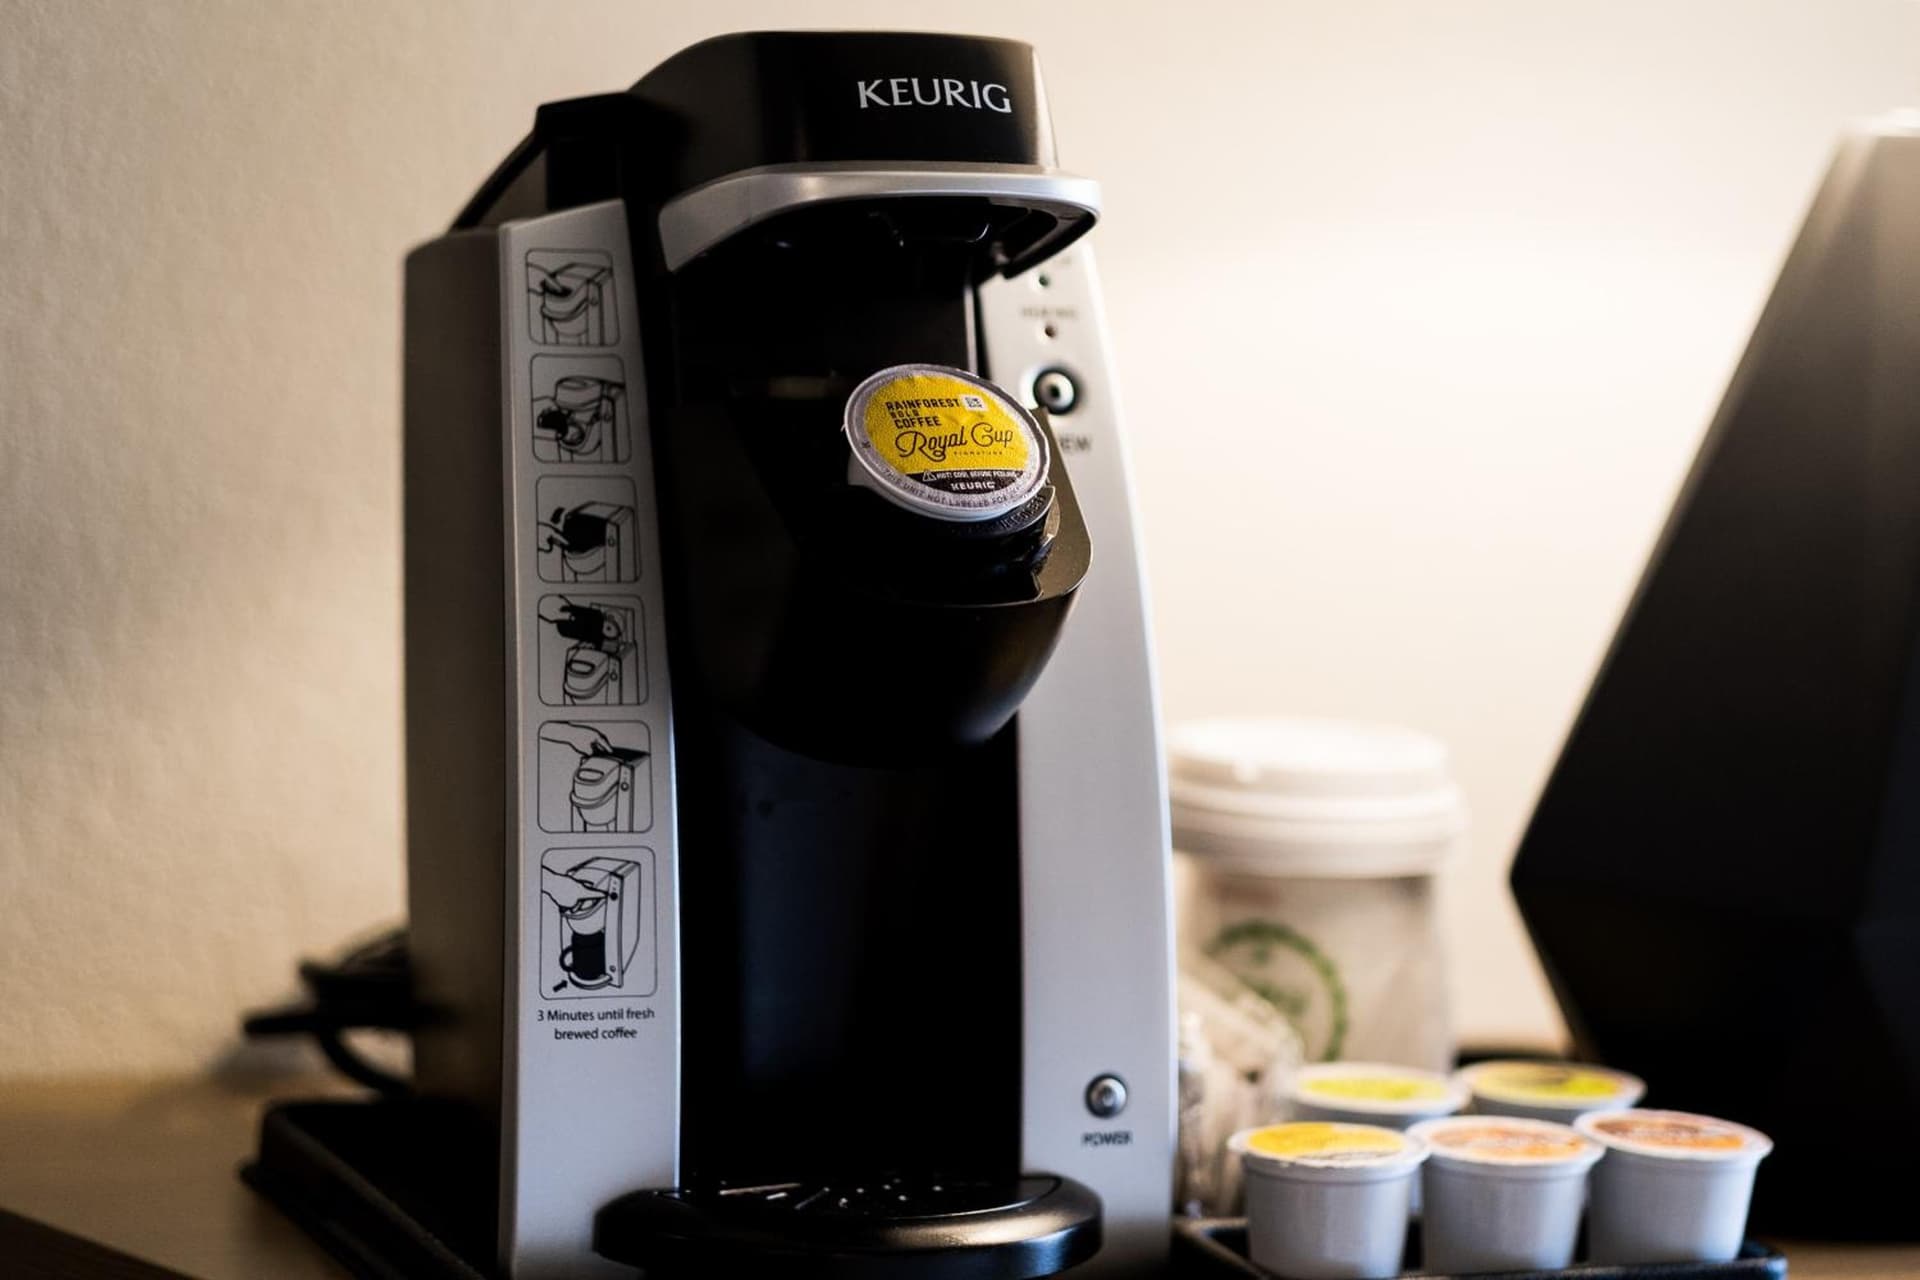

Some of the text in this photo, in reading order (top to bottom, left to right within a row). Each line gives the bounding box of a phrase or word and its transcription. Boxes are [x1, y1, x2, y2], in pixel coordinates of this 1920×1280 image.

[857, 78, 1012, 113] KEURIG
[885, 398, 961, 410] RAINFOREST
[894, 415, 942, 429] COFFEE
[895, 422, 1014, 463] Royal Cup
[950, 481, 996, 491] KEURIG
[537, 1007, 656, 1022] 3 Minutes until fresh
[554, 1026, 638, 1040] brewed coffee
[1082, 1130, 1134, 1146] POWER
